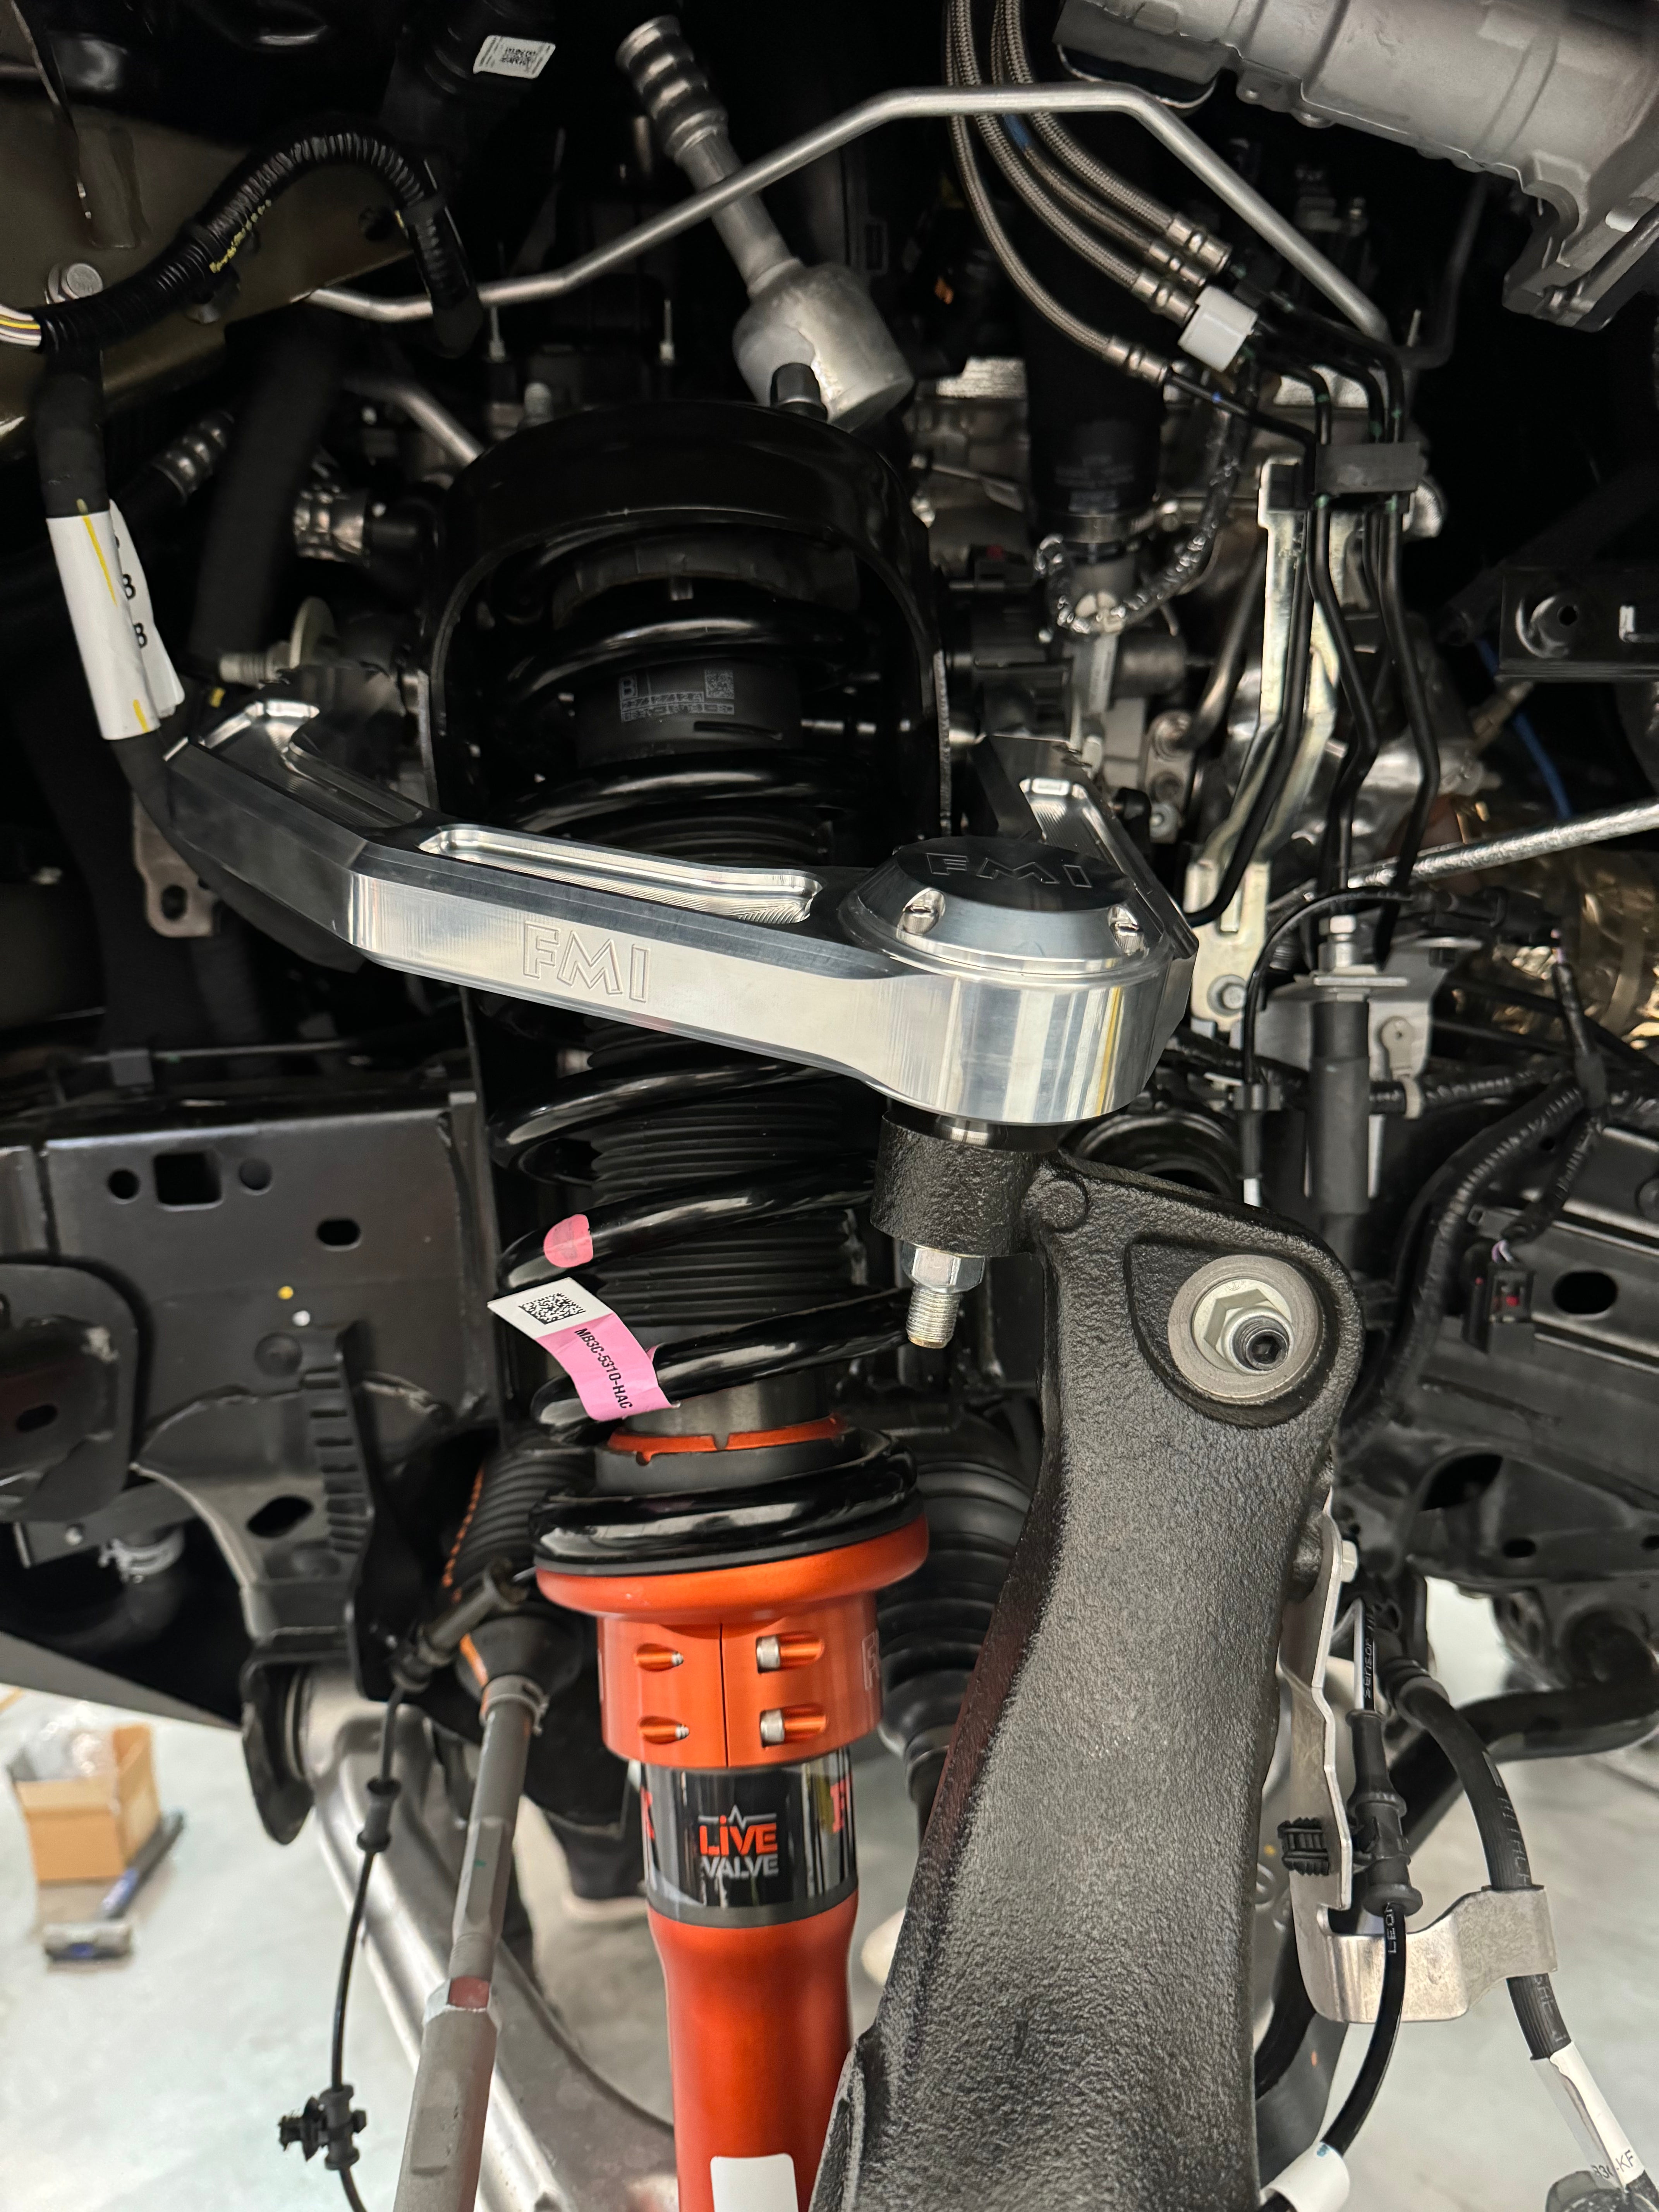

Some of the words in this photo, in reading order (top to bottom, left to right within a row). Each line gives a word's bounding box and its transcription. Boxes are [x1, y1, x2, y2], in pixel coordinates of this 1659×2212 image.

[926, 852, 1092, 888] FMI
[524, 921, 651, 1003] FMI
[574, 1328, 633, 1409] MB3C-5310-HAC
[701, 1854, 779, 1879] VALVE
